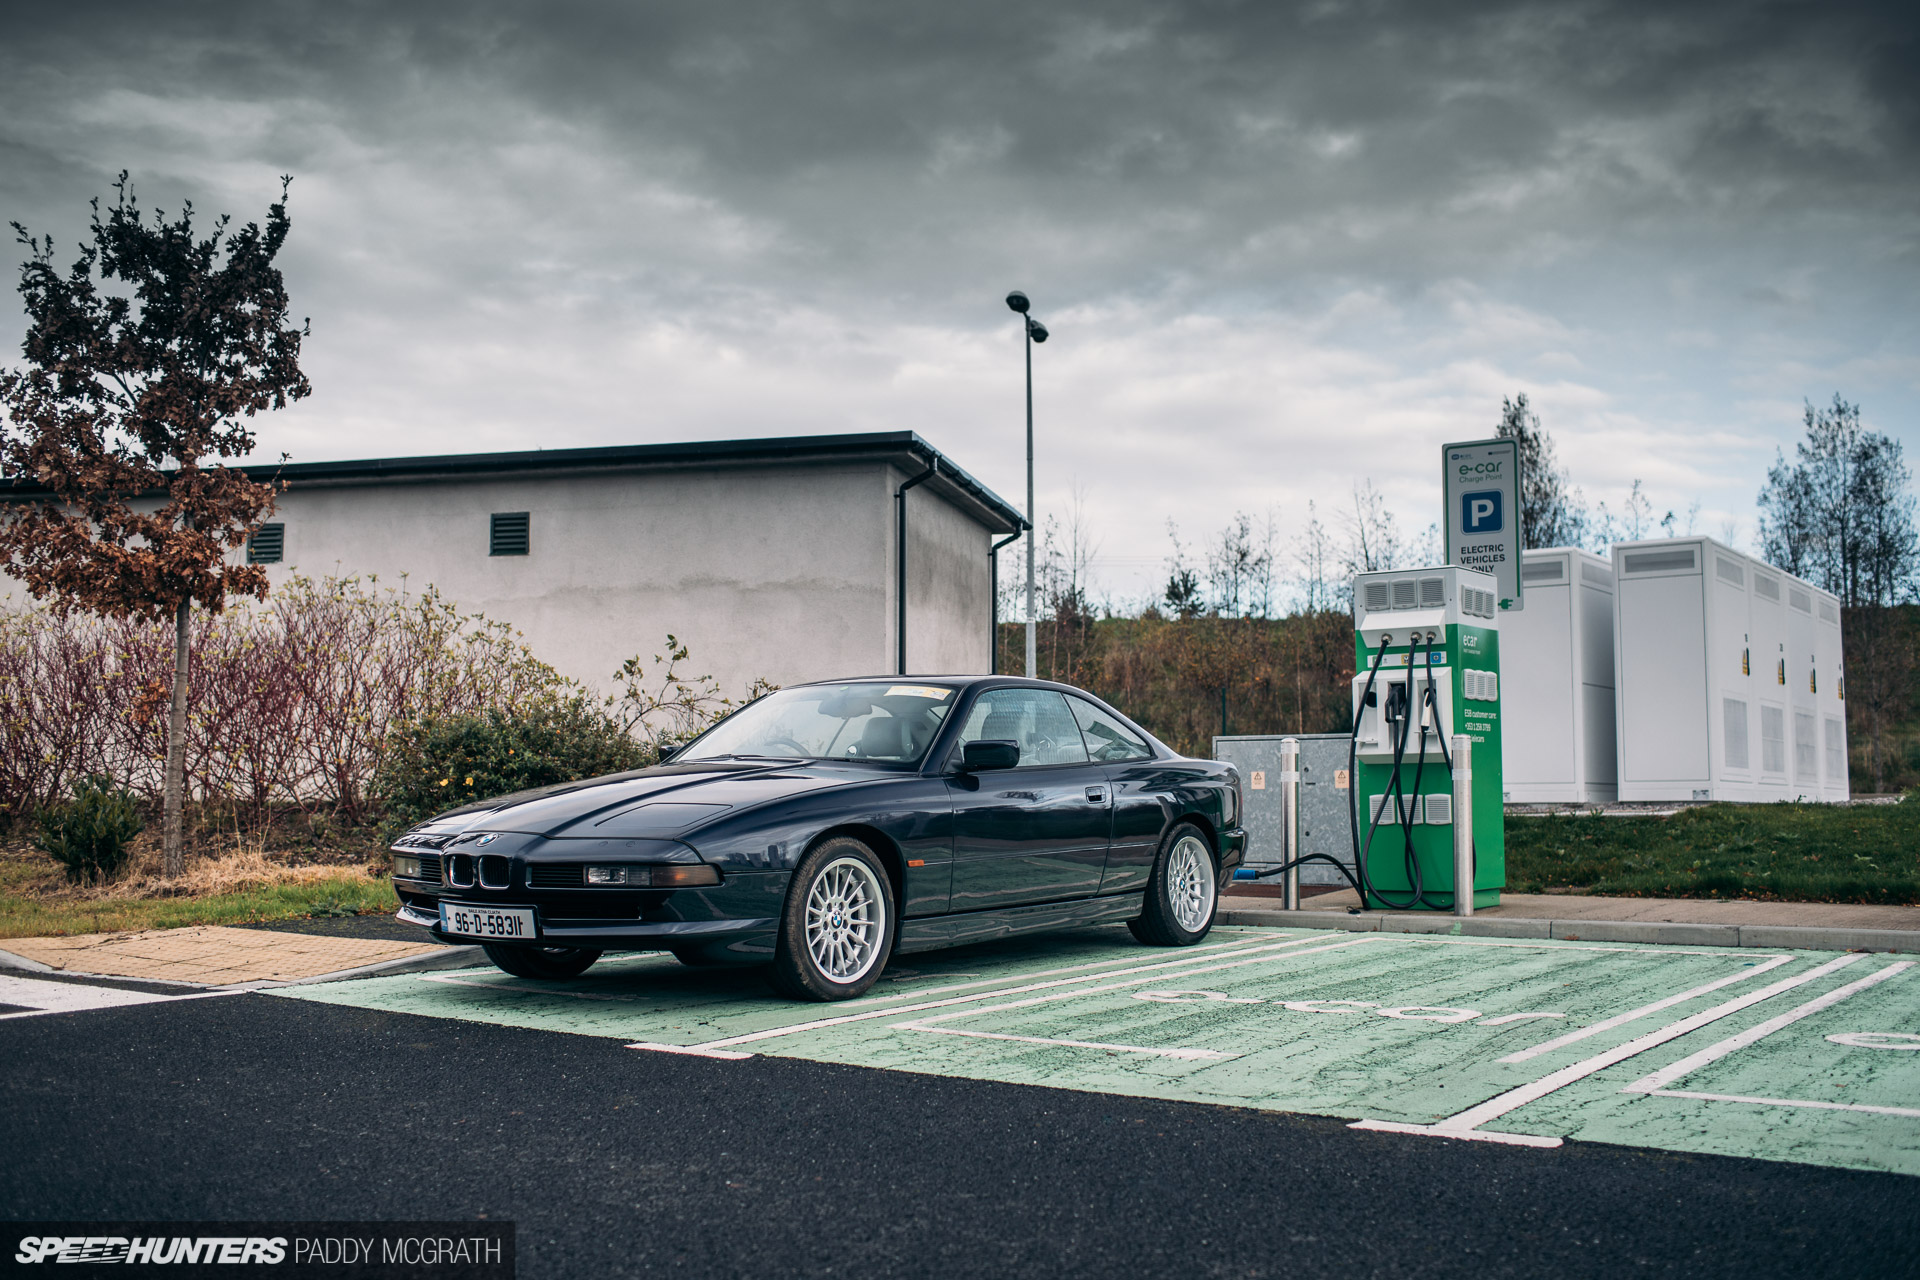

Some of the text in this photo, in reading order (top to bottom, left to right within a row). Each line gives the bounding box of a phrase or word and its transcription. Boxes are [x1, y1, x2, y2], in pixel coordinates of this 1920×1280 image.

[1471, 499, 1494, 527] P
[1461, 544, 1504, 554] ELECTRIC
[1460, 554, 1505, 564] VEHICLES
[1463, 634, 1478, 647] ecar
[455, 912, 523, 936] 96-D-58311
